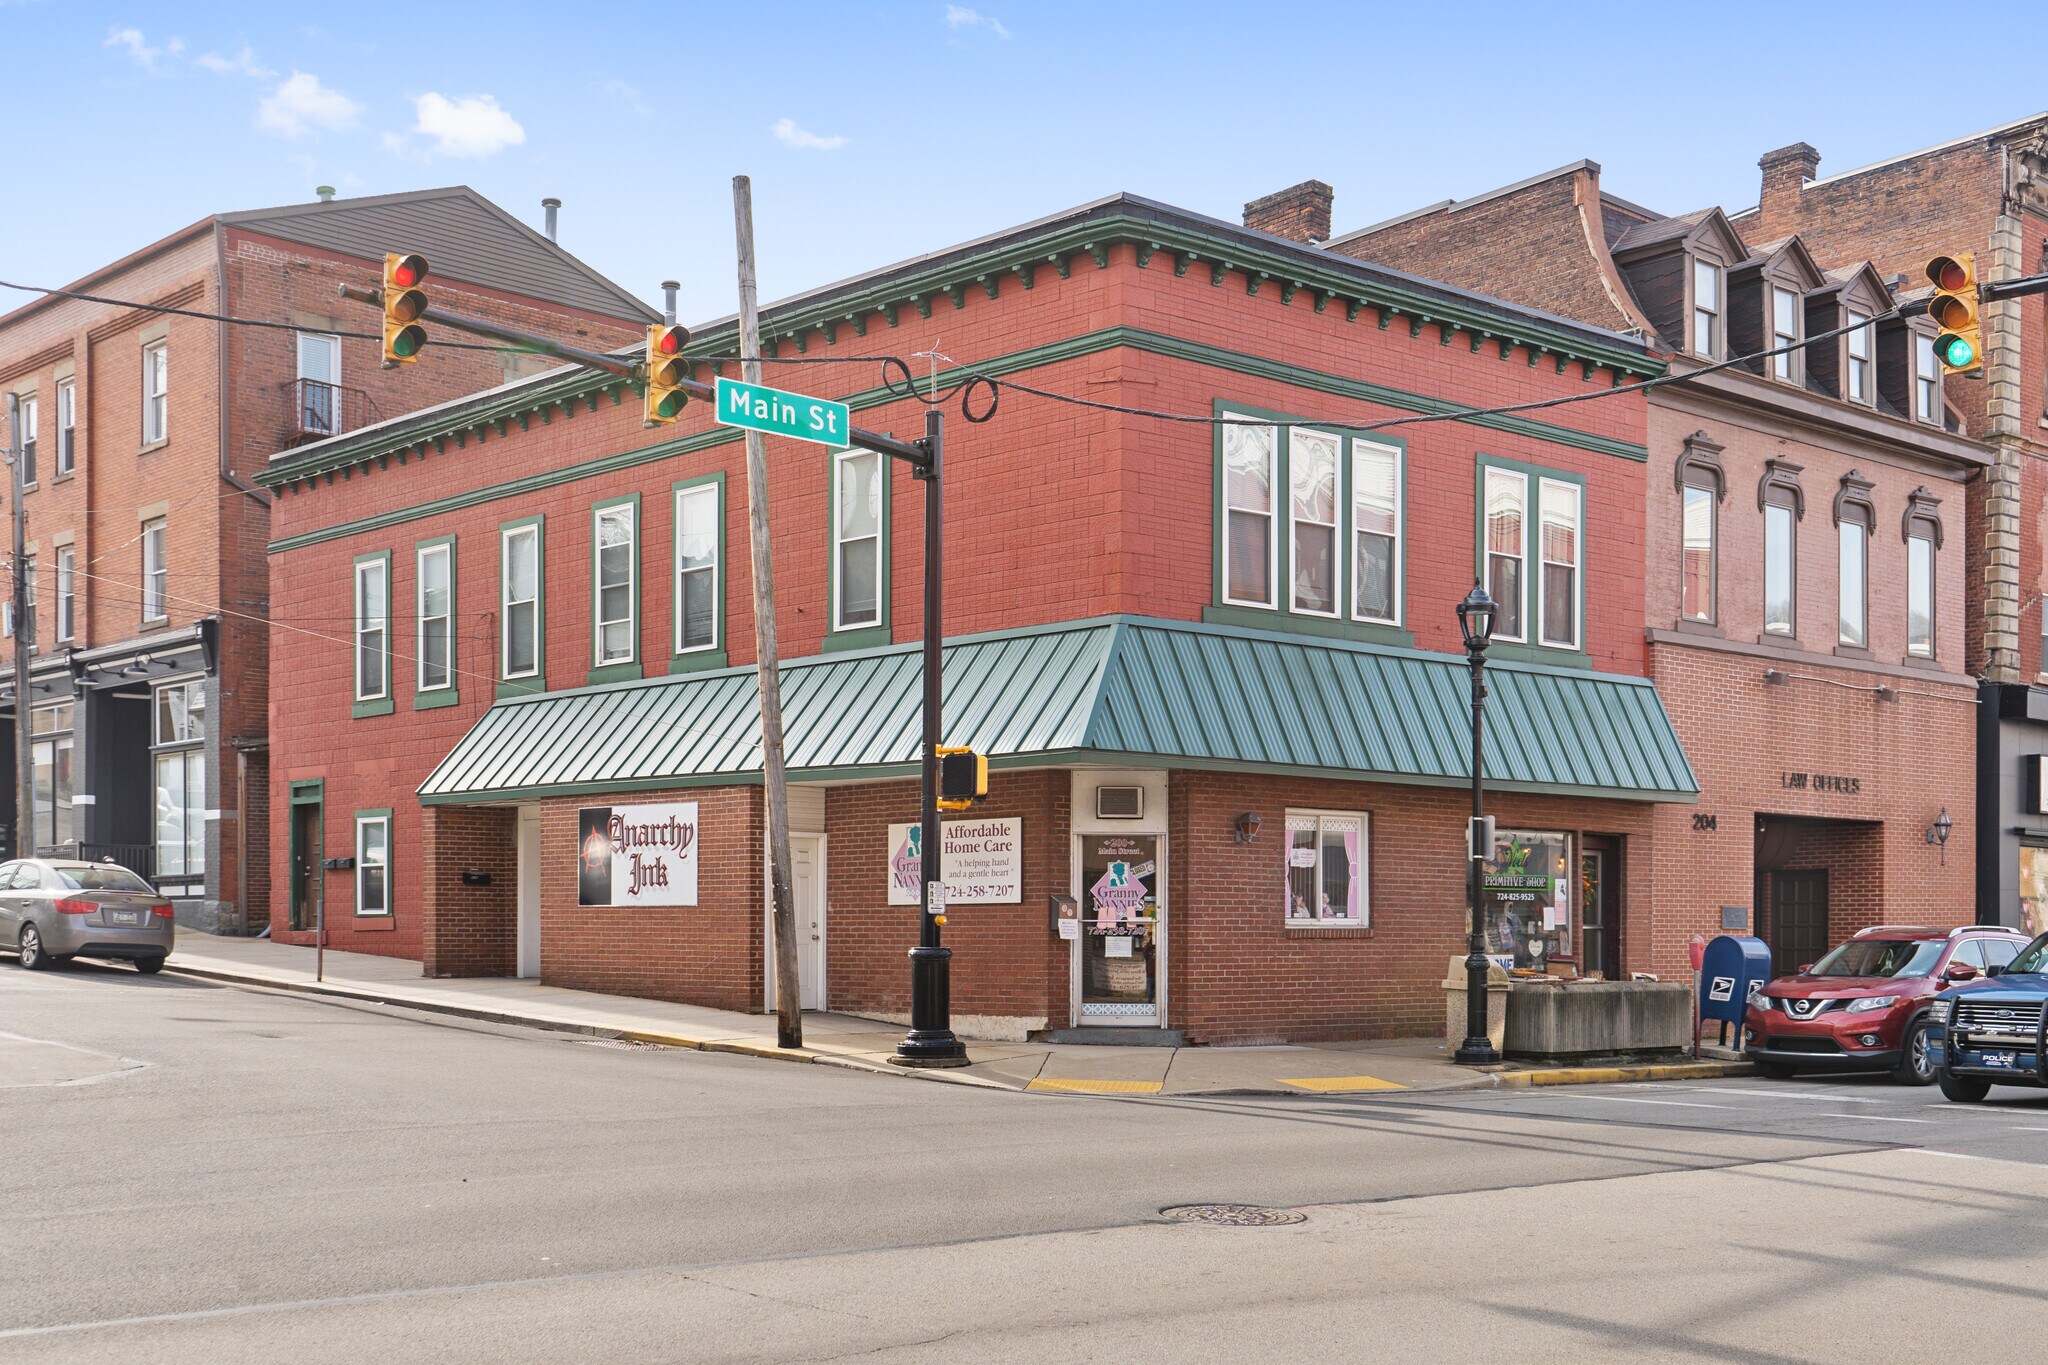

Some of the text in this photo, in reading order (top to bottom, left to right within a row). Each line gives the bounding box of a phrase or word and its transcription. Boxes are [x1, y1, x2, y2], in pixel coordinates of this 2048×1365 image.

[730, 387, 837, 433] Main St
[1782, 772, 1860, 794] LAW OFFICES
[1692, 813, 1717, 831] 204
[606, 813, 694, 859] Anarchy
[945, 823, 1011, 839] Affordable
[944, 840, 1013, 854] Home Care
[896, 856, 922, 872] Gran
[964, 859, 990, 869] helping
[992, 857, 1009, 866] hand
[627, 853, 669, 896] Ink
[949, 870, 961, 878] and
[968, 869, 989, 879] gentle
[945, 884, 1015, 898] 724-258-7207
[1097, 885, 1141, 898] Granny
[1497, 893, 1535, 901] 724-825-9525
[1982, 1054, 2013, 1062] POLICE
